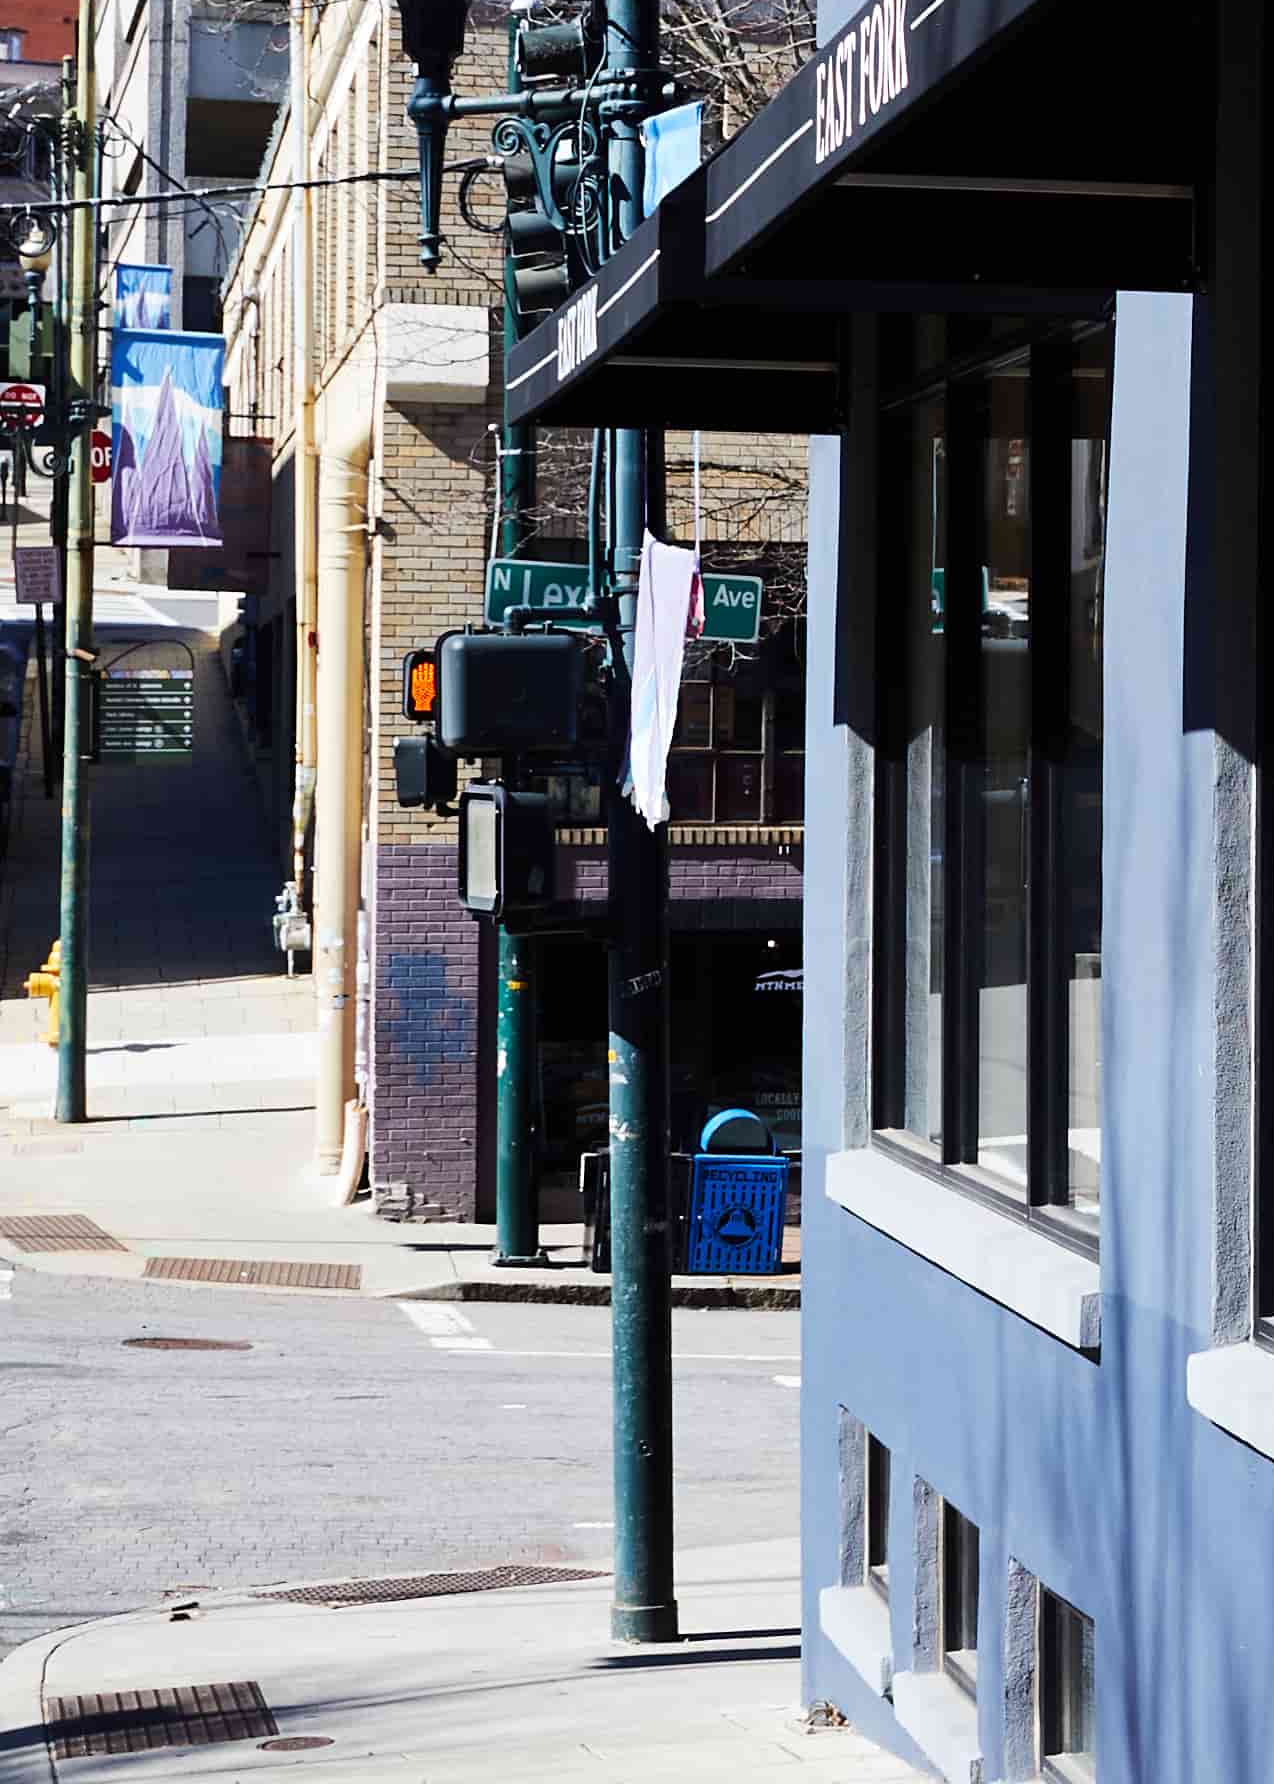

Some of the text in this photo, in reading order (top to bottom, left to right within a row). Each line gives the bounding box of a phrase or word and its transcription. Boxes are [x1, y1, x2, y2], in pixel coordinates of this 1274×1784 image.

[816, 31, 856, 165] EAST
[558, 284, 598, 381] EAST FORK
[21, 392, 37, 401] NOT
[494, 567, 512, 591] N
[712, 583, 756, 609] Ave
[703, 1169, 777, 1183] RECYCLING
